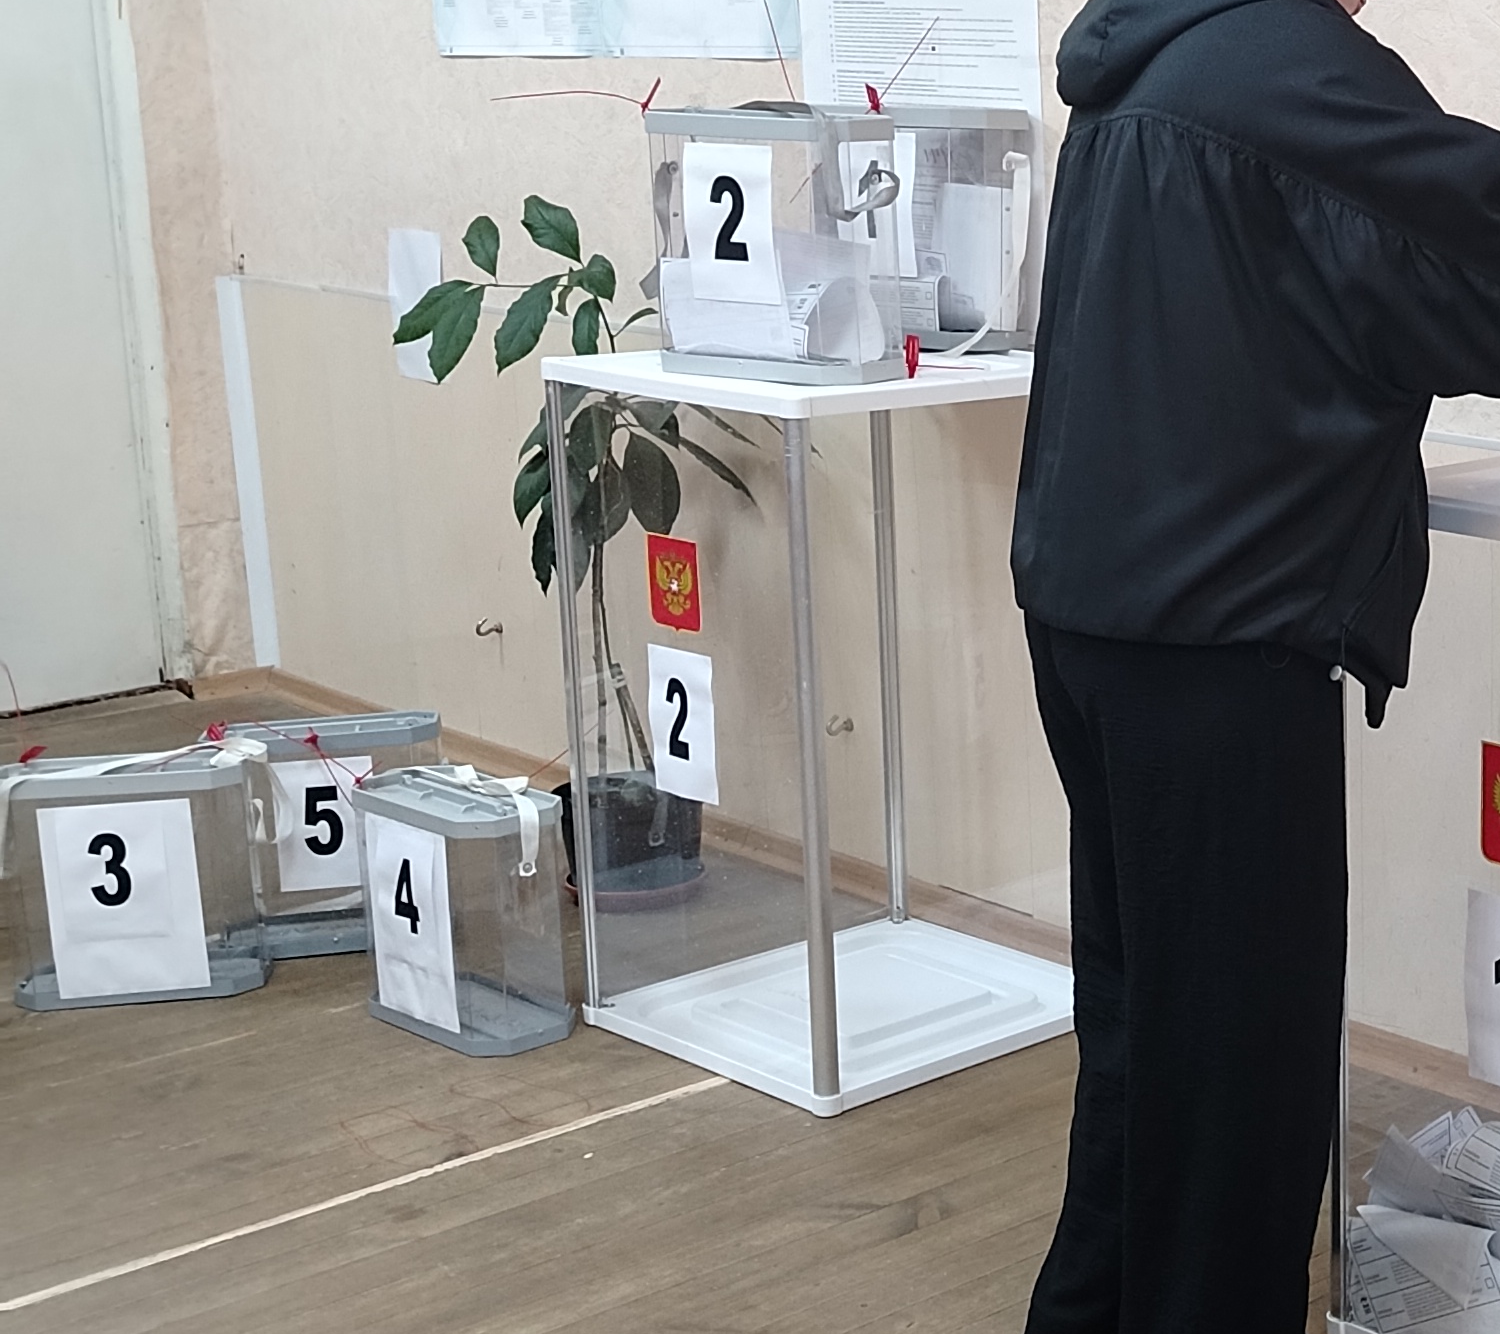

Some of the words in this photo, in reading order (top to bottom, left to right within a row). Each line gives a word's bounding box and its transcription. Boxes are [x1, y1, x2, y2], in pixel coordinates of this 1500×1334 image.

[709, 175, 749, 262] 2
[665, 676, 691, 762] 2
[303, 785, 345, 857] 5
[87, 832, 133, 908] 3
[393, 858, 421, 935] 4
